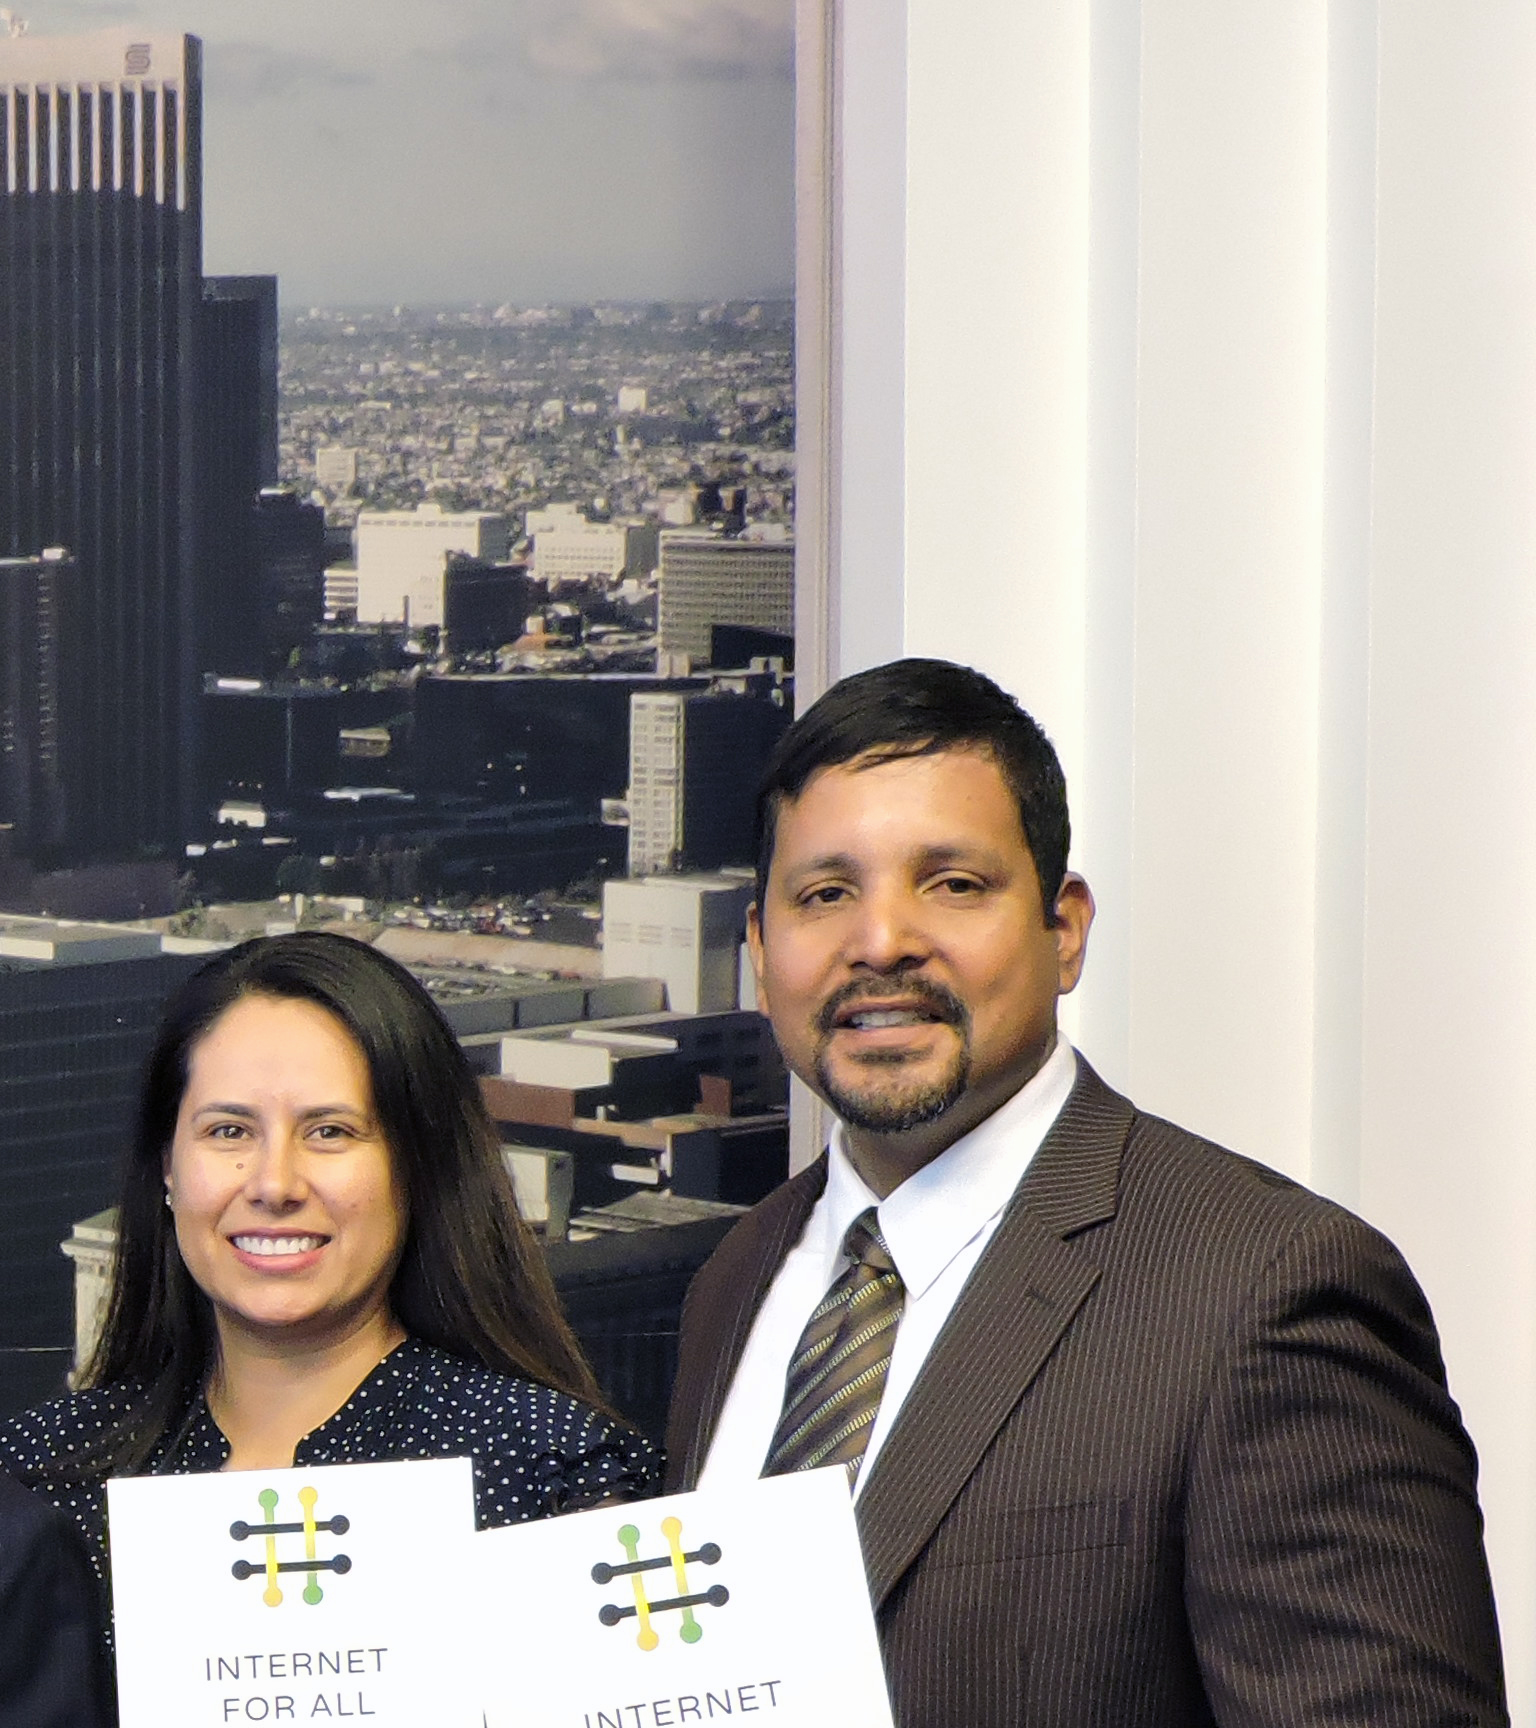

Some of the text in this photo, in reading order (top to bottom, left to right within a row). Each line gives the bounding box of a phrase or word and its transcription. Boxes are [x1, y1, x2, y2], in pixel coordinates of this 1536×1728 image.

[206, 1647, 388, 1682] INTERNET
[223, 1691, 376, 1723] FOR ALL
